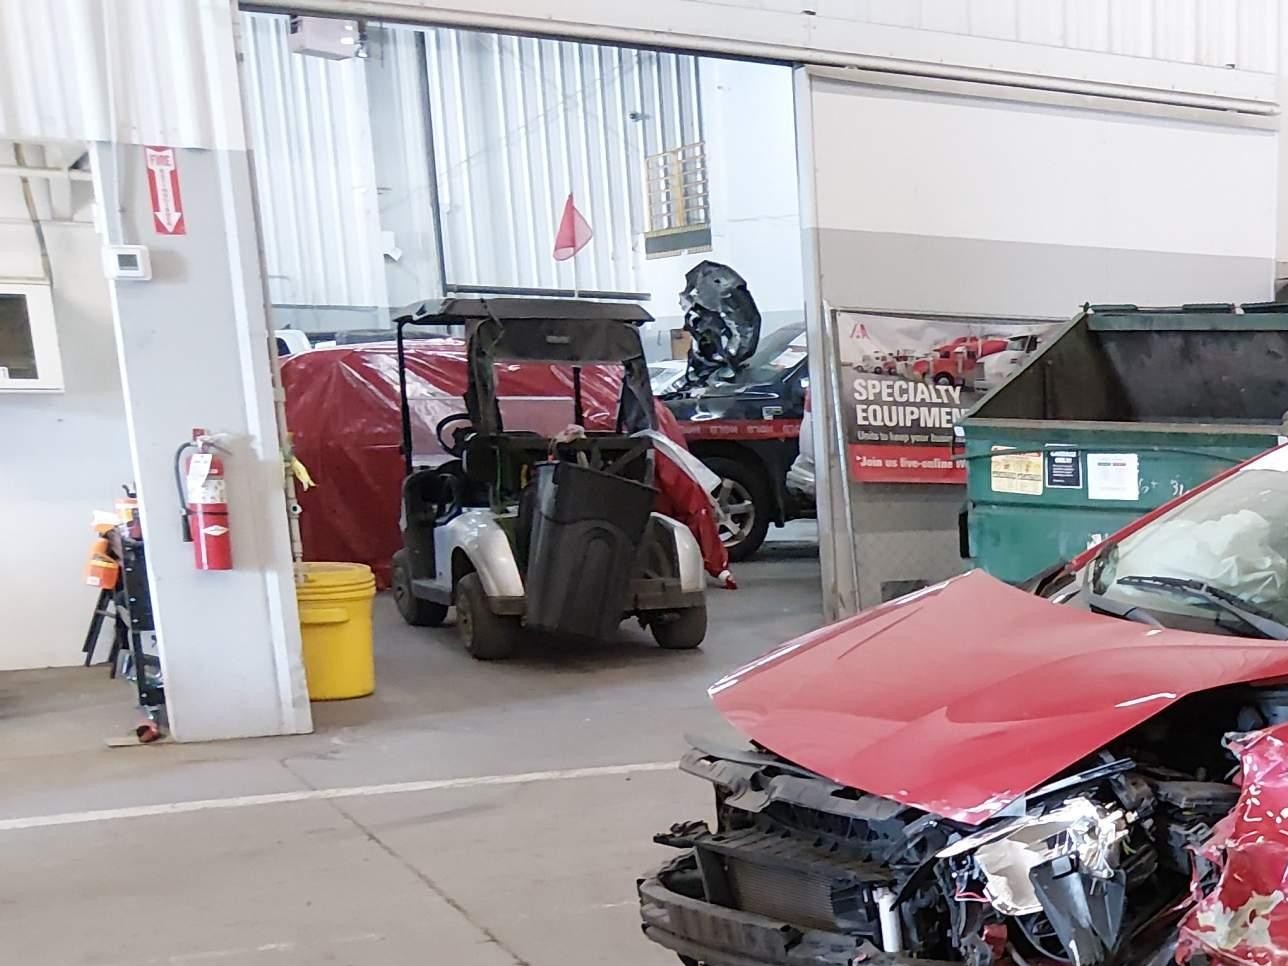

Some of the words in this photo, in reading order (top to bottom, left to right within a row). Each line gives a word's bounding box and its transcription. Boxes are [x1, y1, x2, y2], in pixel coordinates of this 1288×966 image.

[853, 379, 962, 404] SPECIALTY
[855, 404, 971, 428] EQUIPMEN
[861, 456, 883, 467] Join
